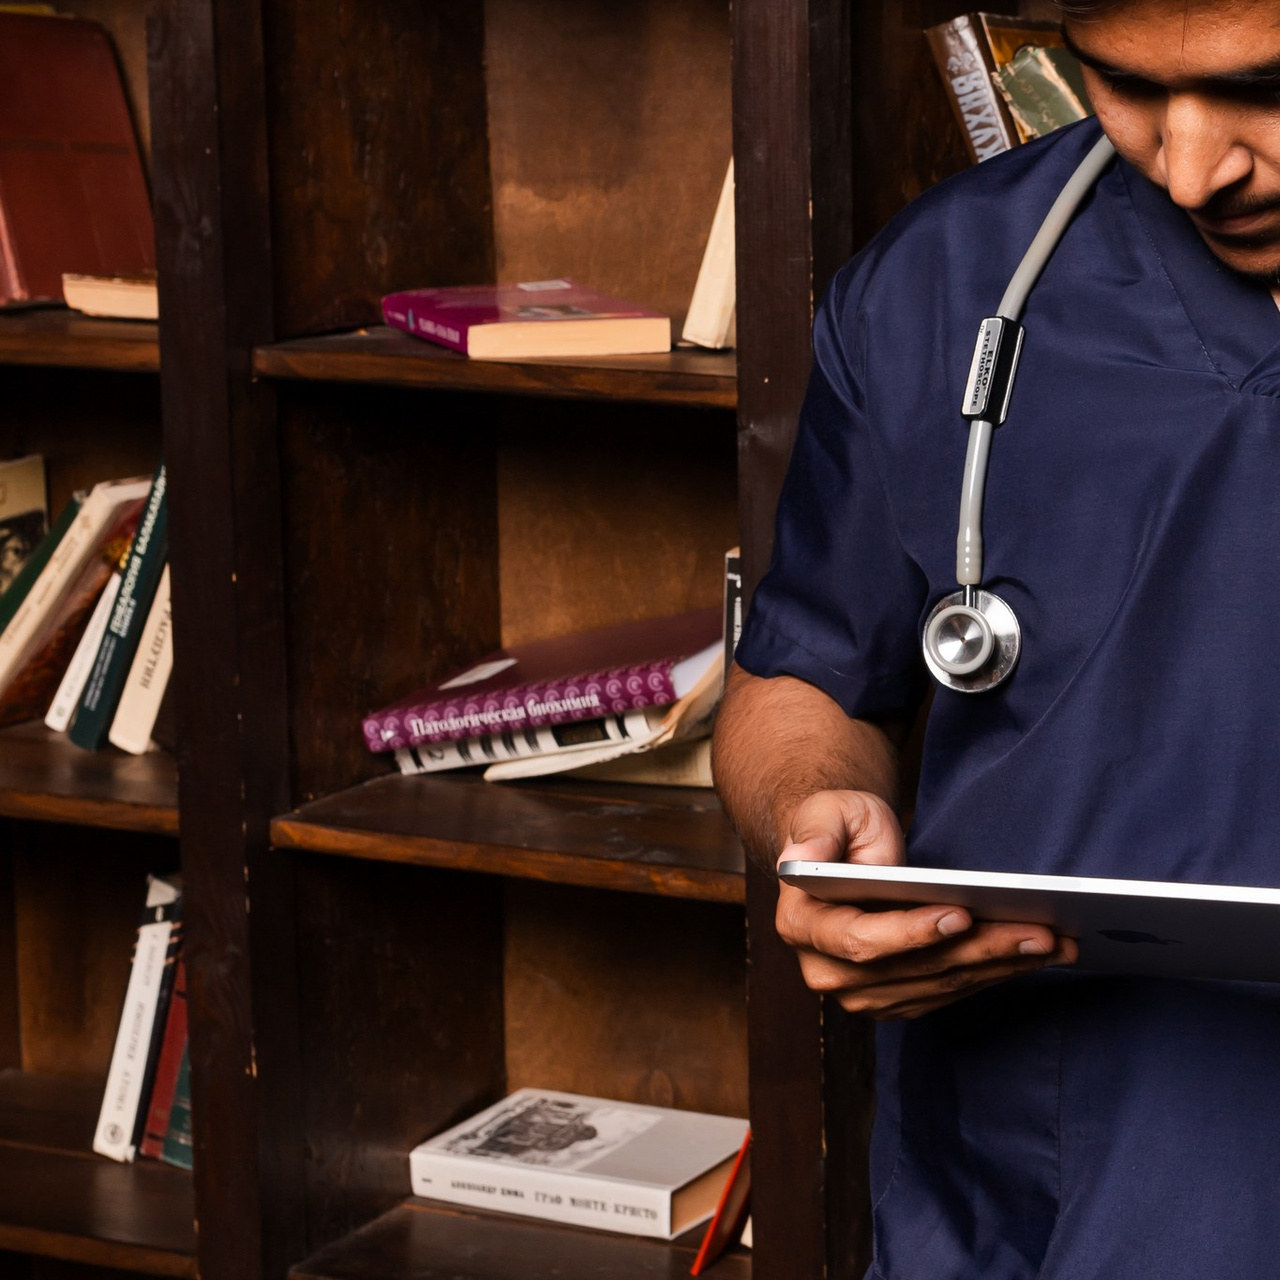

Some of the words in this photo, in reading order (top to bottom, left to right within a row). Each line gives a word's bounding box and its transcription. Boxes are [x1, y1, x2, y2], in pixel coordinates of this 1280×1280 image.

[951, 70, 1006, 164] КУХНЯ
[972, 330, 991, 407] STETHOSCOPE
[410, 704, 527, 738] Патологическая
[527, 693, 600, 718] биохимия
